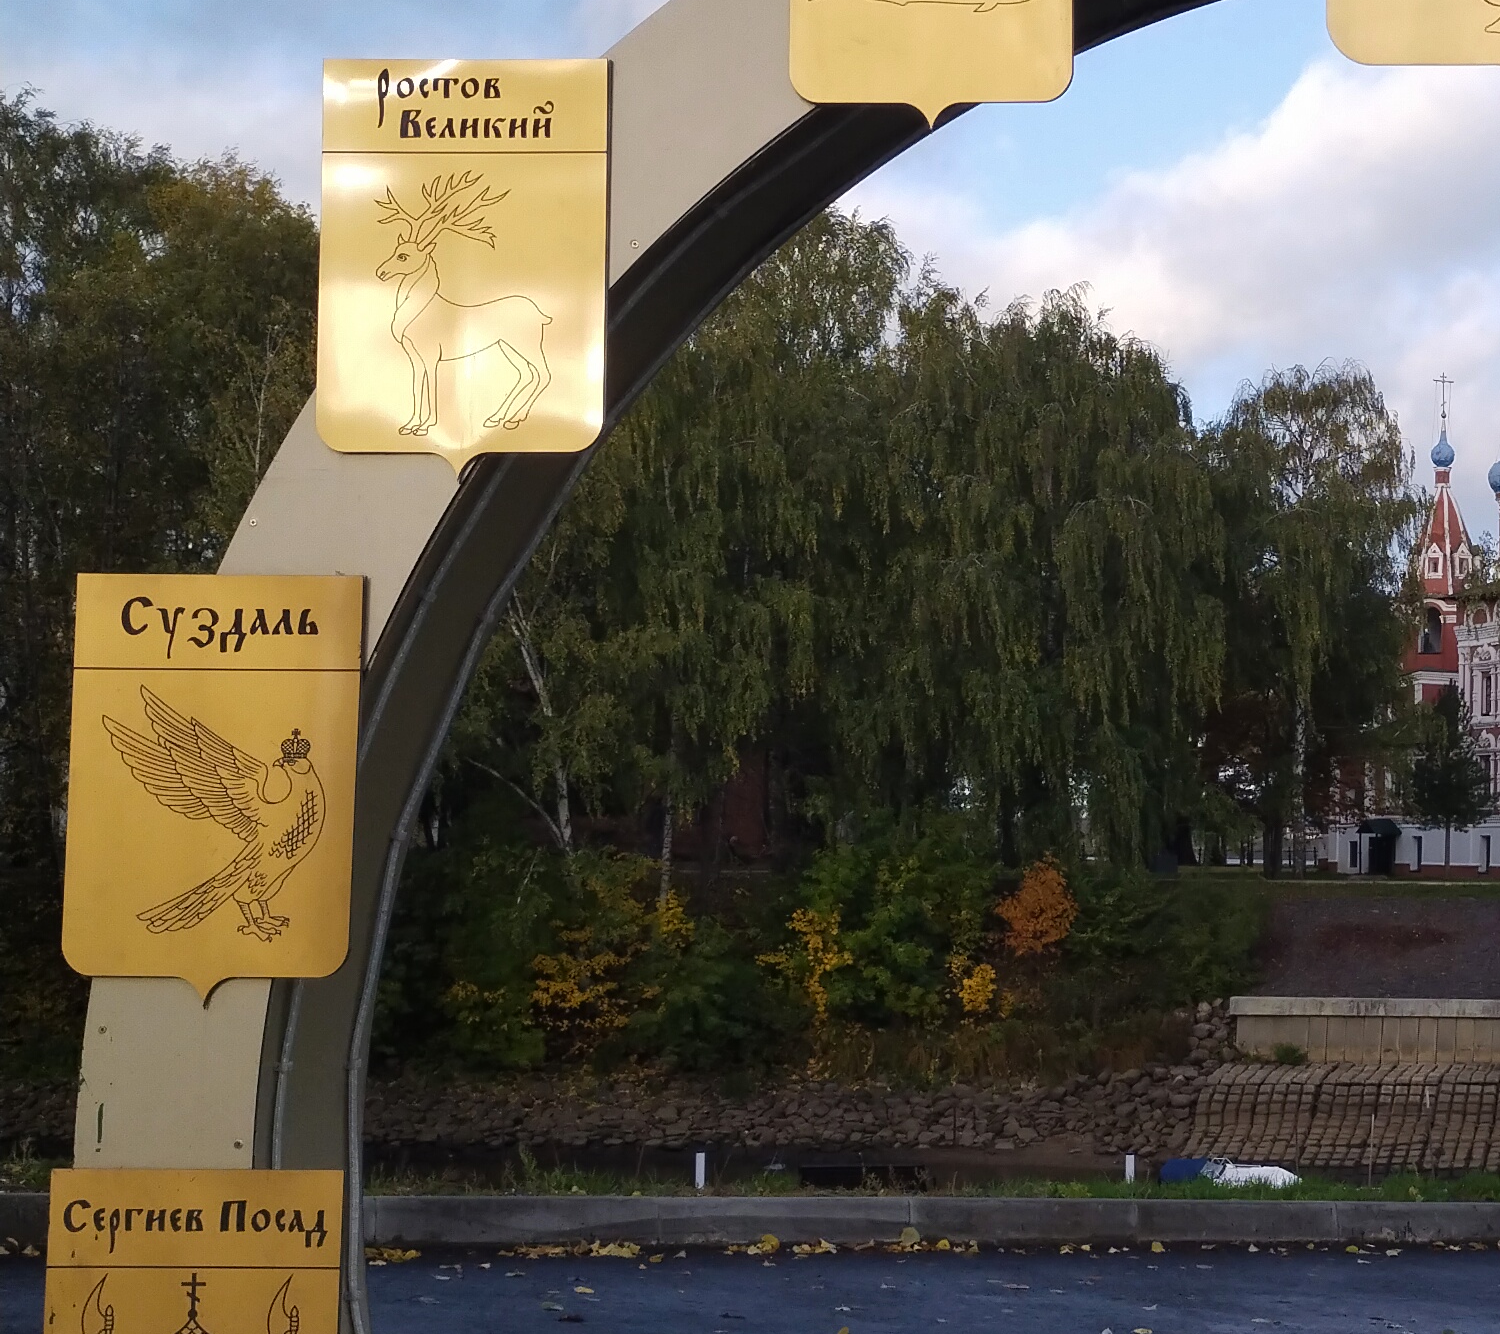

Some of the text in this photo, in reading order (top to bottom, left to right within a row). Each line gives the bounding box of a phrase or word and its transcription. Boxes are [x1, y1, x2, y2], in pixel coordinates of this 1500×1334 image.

[376, 67, 502, 129] Ростов
[399, 100, 555, 139] Великий
[120, 596, 320, 660] Суздаль
[62, 1199, 329, 1255] Сергиев Посад
